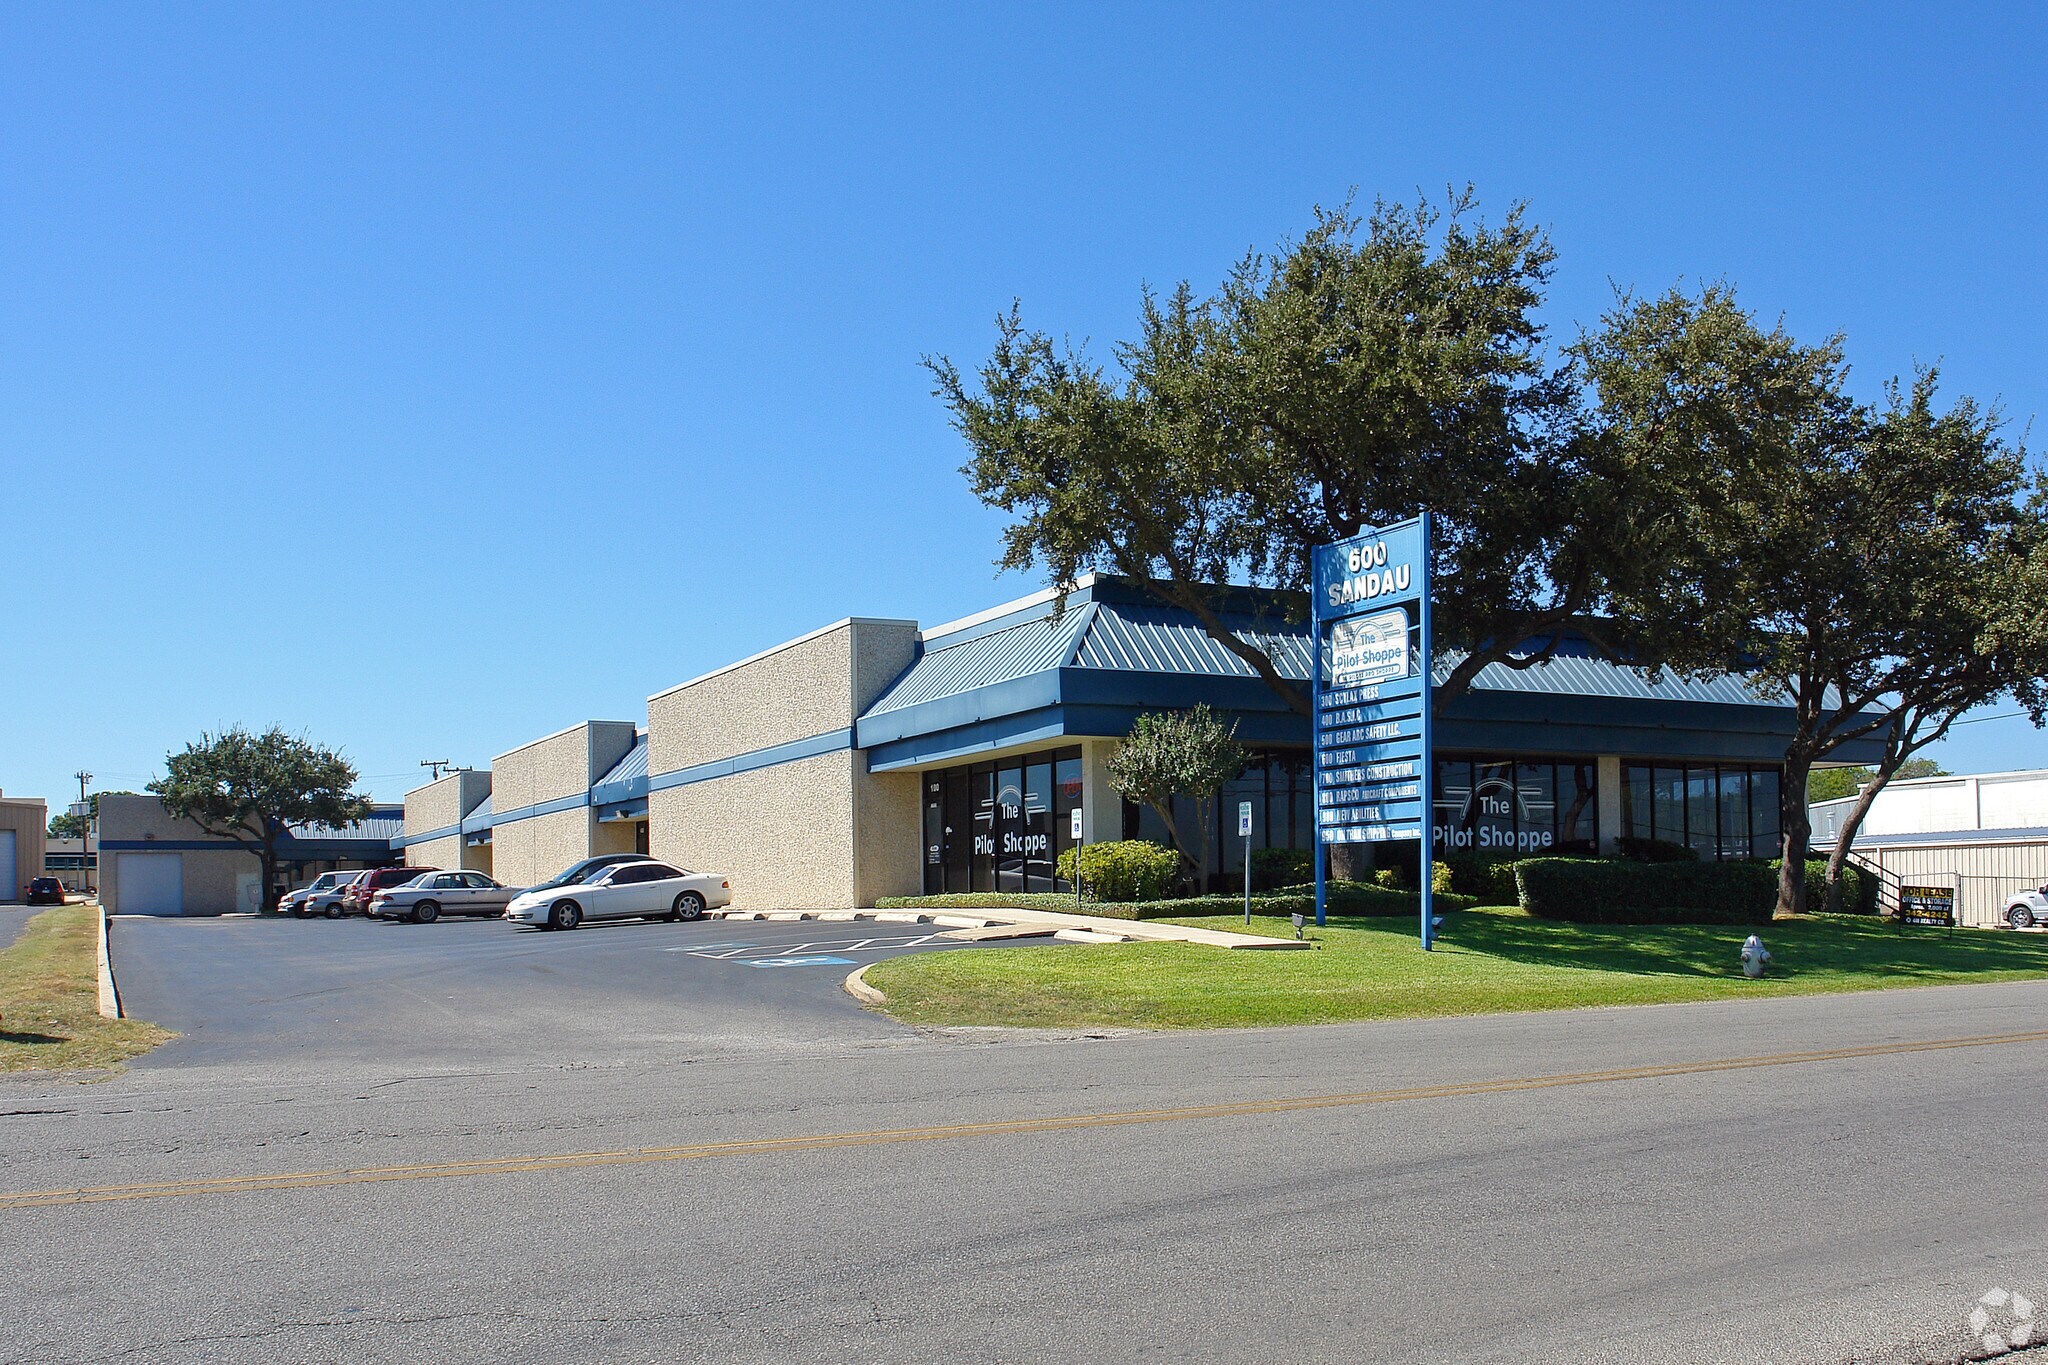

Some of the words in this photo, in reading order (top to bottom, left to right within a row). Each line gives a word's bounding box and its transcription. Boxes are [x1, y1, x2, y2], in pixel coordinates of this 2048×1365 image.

[1348, 541, 1387, 572] 600
[1328, 563, 1410, 607] SANDAU
[1360, 633, 1376, 646] The
[1337, 653, 1359, 669] Pilot
[1362, 647, 1402, 665] Shoppe
[1321, 694, 1332, 707] 300
[1359, 686, 1379, 700] PRESS
[1321, 714, 1333, 726] 400
[1321, 733, 1333, 746] 500
[1336, 730, 1351, 744] GEAR
[1352, 728, 1365, 741] ARC
[1365, 724, 1387, 740] SAFETY
[1321, 752, 1333, 765] 600
[1336, 750, 1356, 764] FIESTA
[1322, 773, 1333, 784] 700
[1366, 762, 1413, 779] CONSTRUCTION
[930, 783, 940, 793] 100
[1336, 789, 1360, 802] RAPSCO
[1384, 784, 1417, 798] COMPONENTS
[1001, 801, 1019, 819] The
[1351, 806, 1380, 821] ABILITIES
[1480, 795, 1510, 814] The
[1362, 827, 1391, 840] SHIPPING
[1432, 824, 1474, 847] Pilot
[1479, 824, 1552, 853] Shoppe
[974, 834, 995, 855] Pilo
[1003, 831, 1047, 856] Shoppe
[1902, 896, 1921, 904] OFFICE
[1926, 897, 1952, 905] STORAGE
[1903, 887, 1921, 896] FOR
[1923, 888, 1952, 898] LEASE
[1905, 909, 1948, 919] 342-4242
